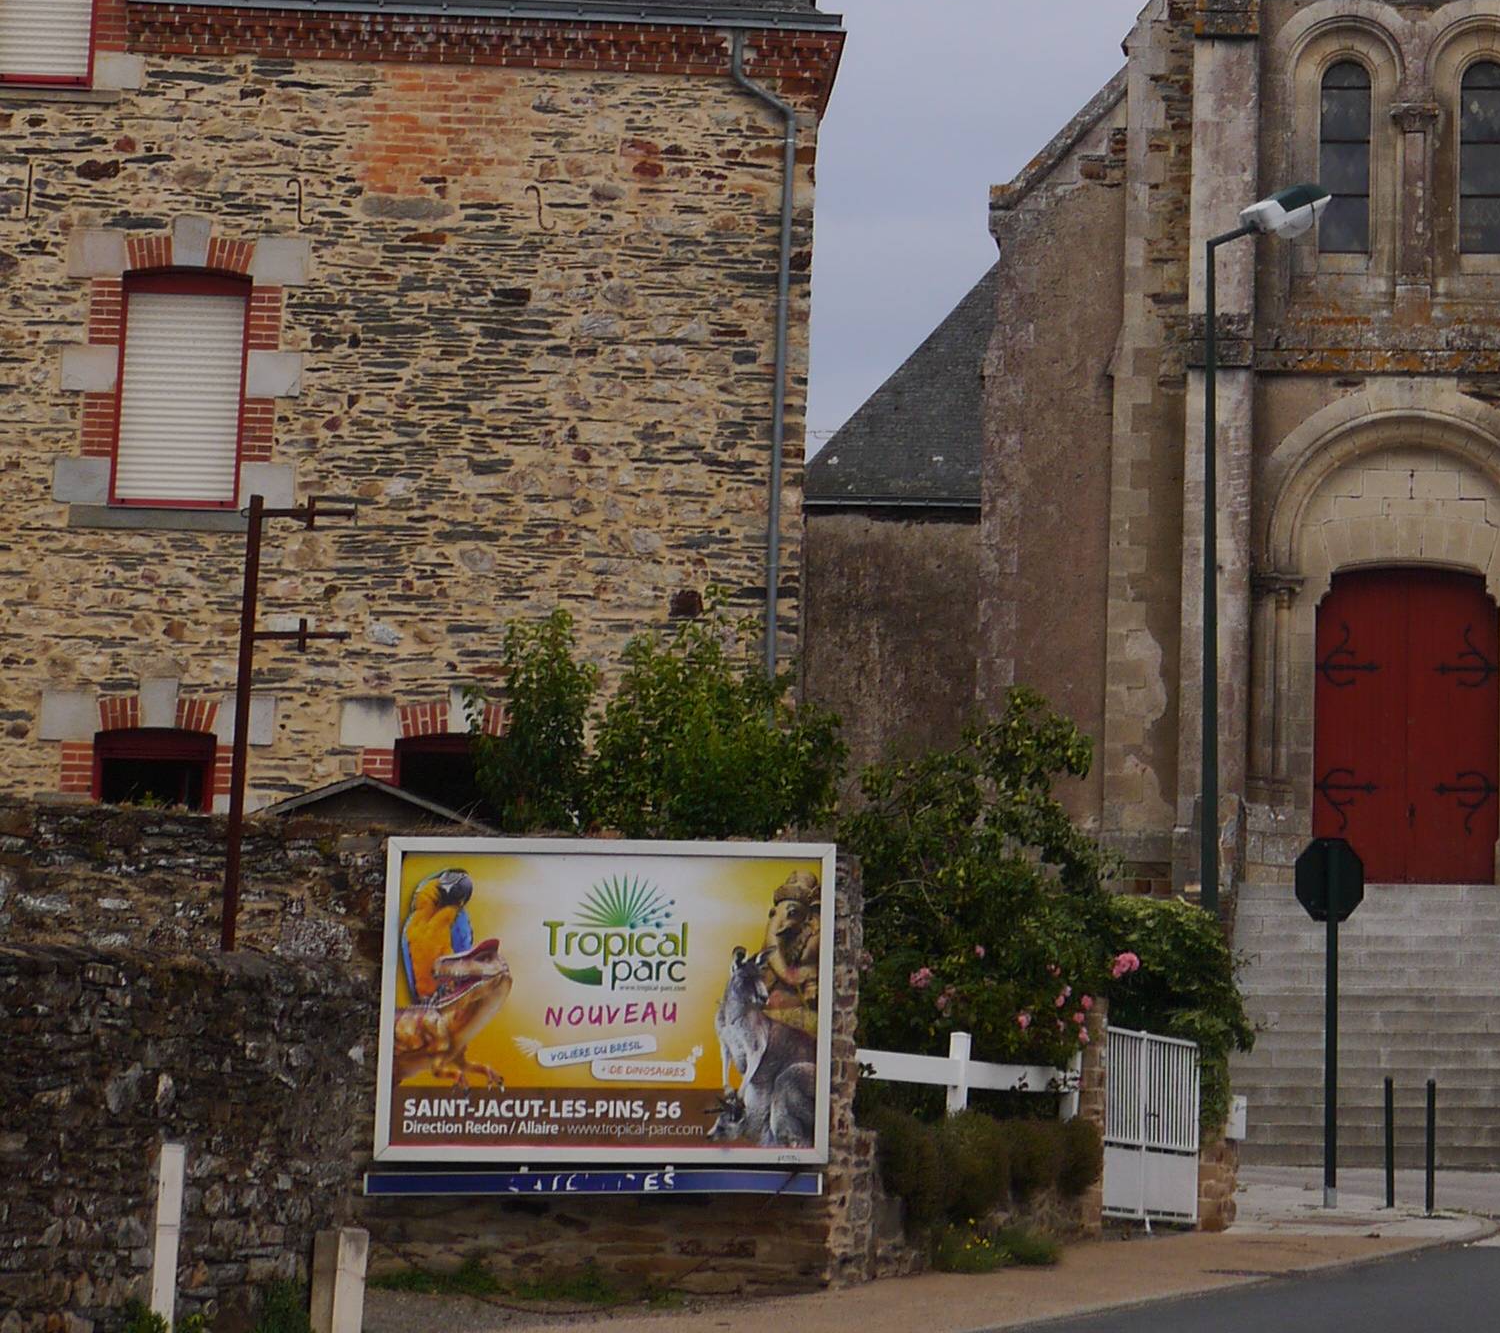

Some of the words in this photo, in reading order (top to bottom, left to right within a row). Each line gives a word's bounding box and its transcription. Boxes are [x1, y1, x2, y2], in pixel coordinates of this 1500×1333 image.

[543, 921, 688, 966] Tropical
[611, 959, 687, 990] parc
[545, 1001, 677, 1027] NOUVEAU
[594, 1045, 607, 1056] DU
[609, 1065, 623, 1075] DE
[625, 1065, 687, 1077] DINOSAURES
[403, 1098, 650, 1121] SAINT-JACUT-LES-PINS,
[655, 1100, 681, 1119] 56
[402, 1120, 463, 1134] Direction
[465, 1120, 508, 1134] Redon
[509, 1121, 516, 1135] /
[517, 1120, 559, 1134] Allaire
[567, 1122, 703, 1137] www.tropical-parc.com
